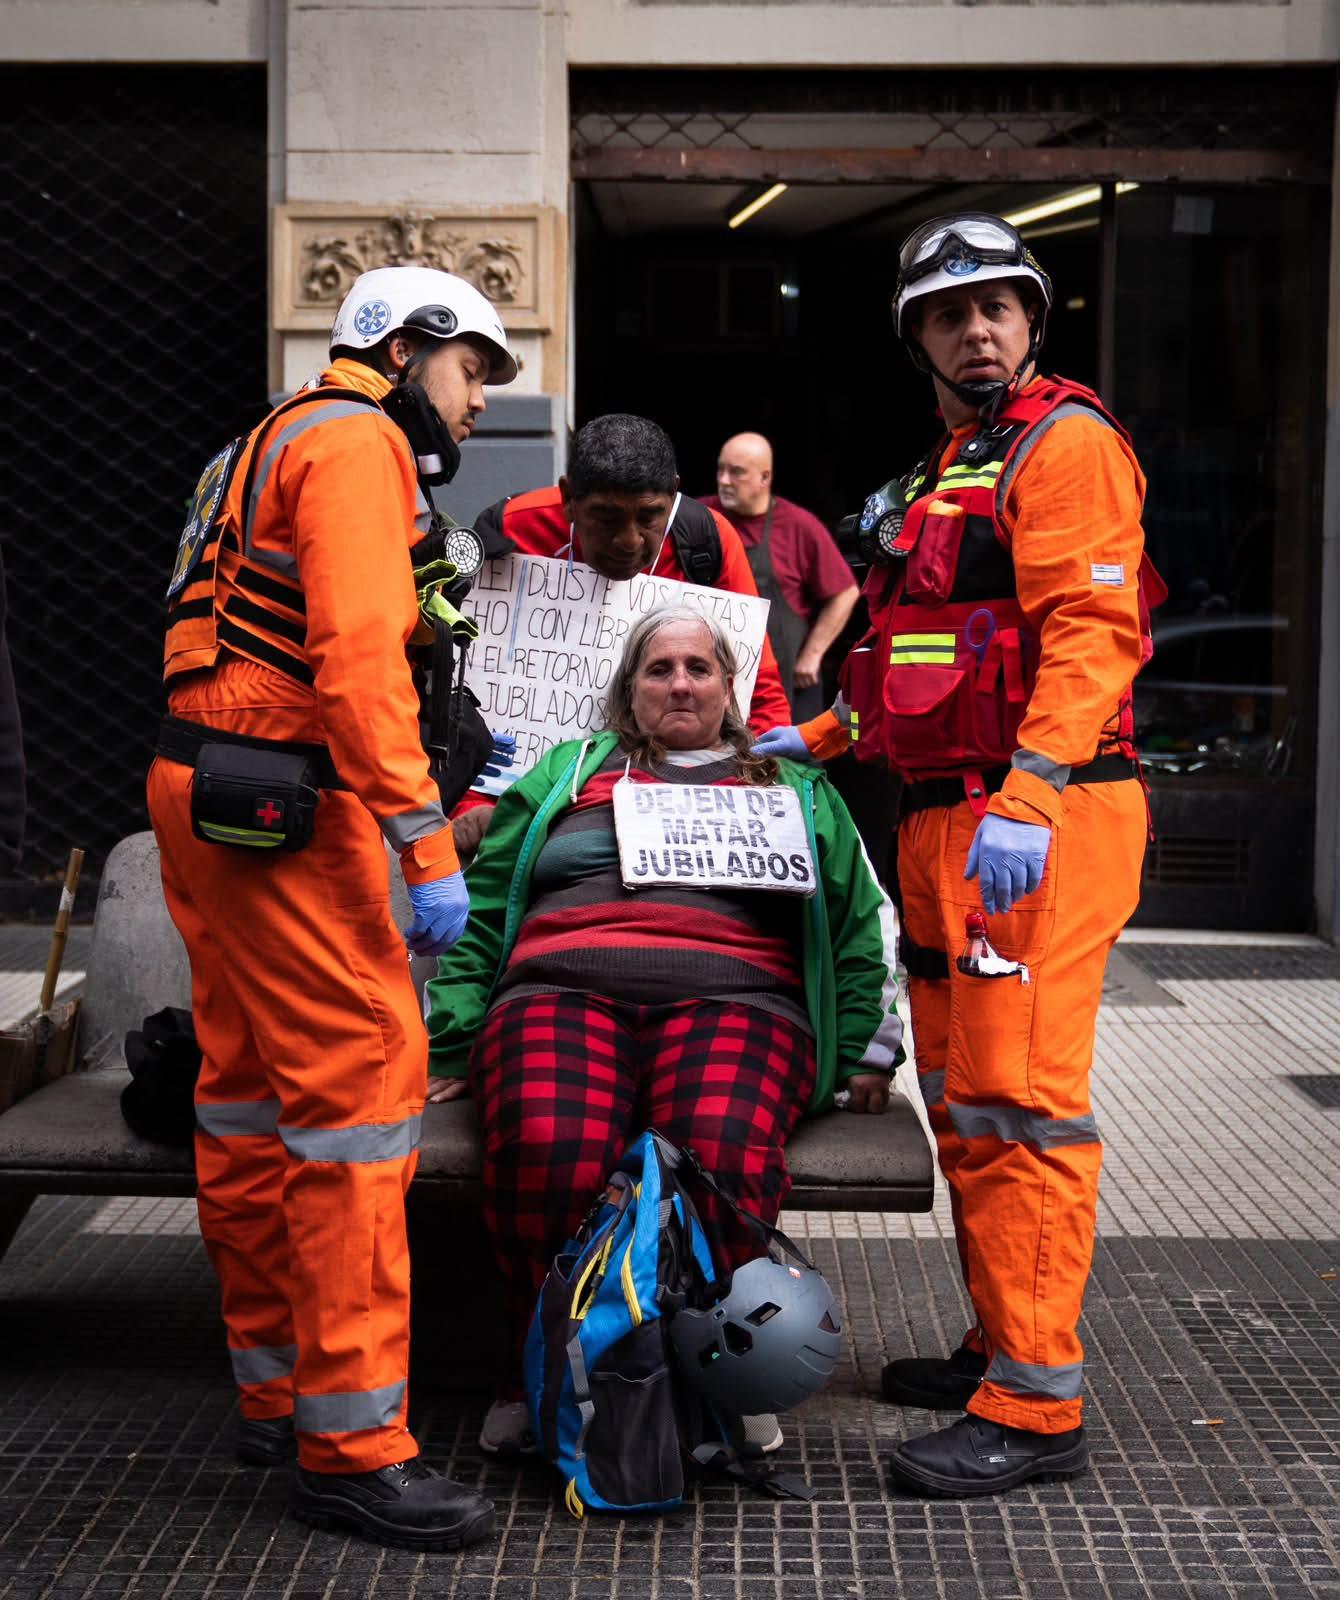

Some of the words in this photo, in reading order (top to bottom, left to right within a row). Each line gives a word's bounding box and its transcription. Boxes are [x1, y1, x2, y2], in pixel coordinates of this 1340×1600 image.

[471, 557, 514, 592] LEI
[527, 607, 572, 643] CON
[733, 640, 762, 681] DY
[484, 645, 508, 675] EL
[512, 648, 613, 690] RETORNO
[478, 681, 609, 733] JUBILADOS
[633, 786, 737, 815] DEJEN
[744, 787, 786, 818] DE
[661, 818, 770, 848] MATAR
[631, 849, 810, 883] JUBILADOS
